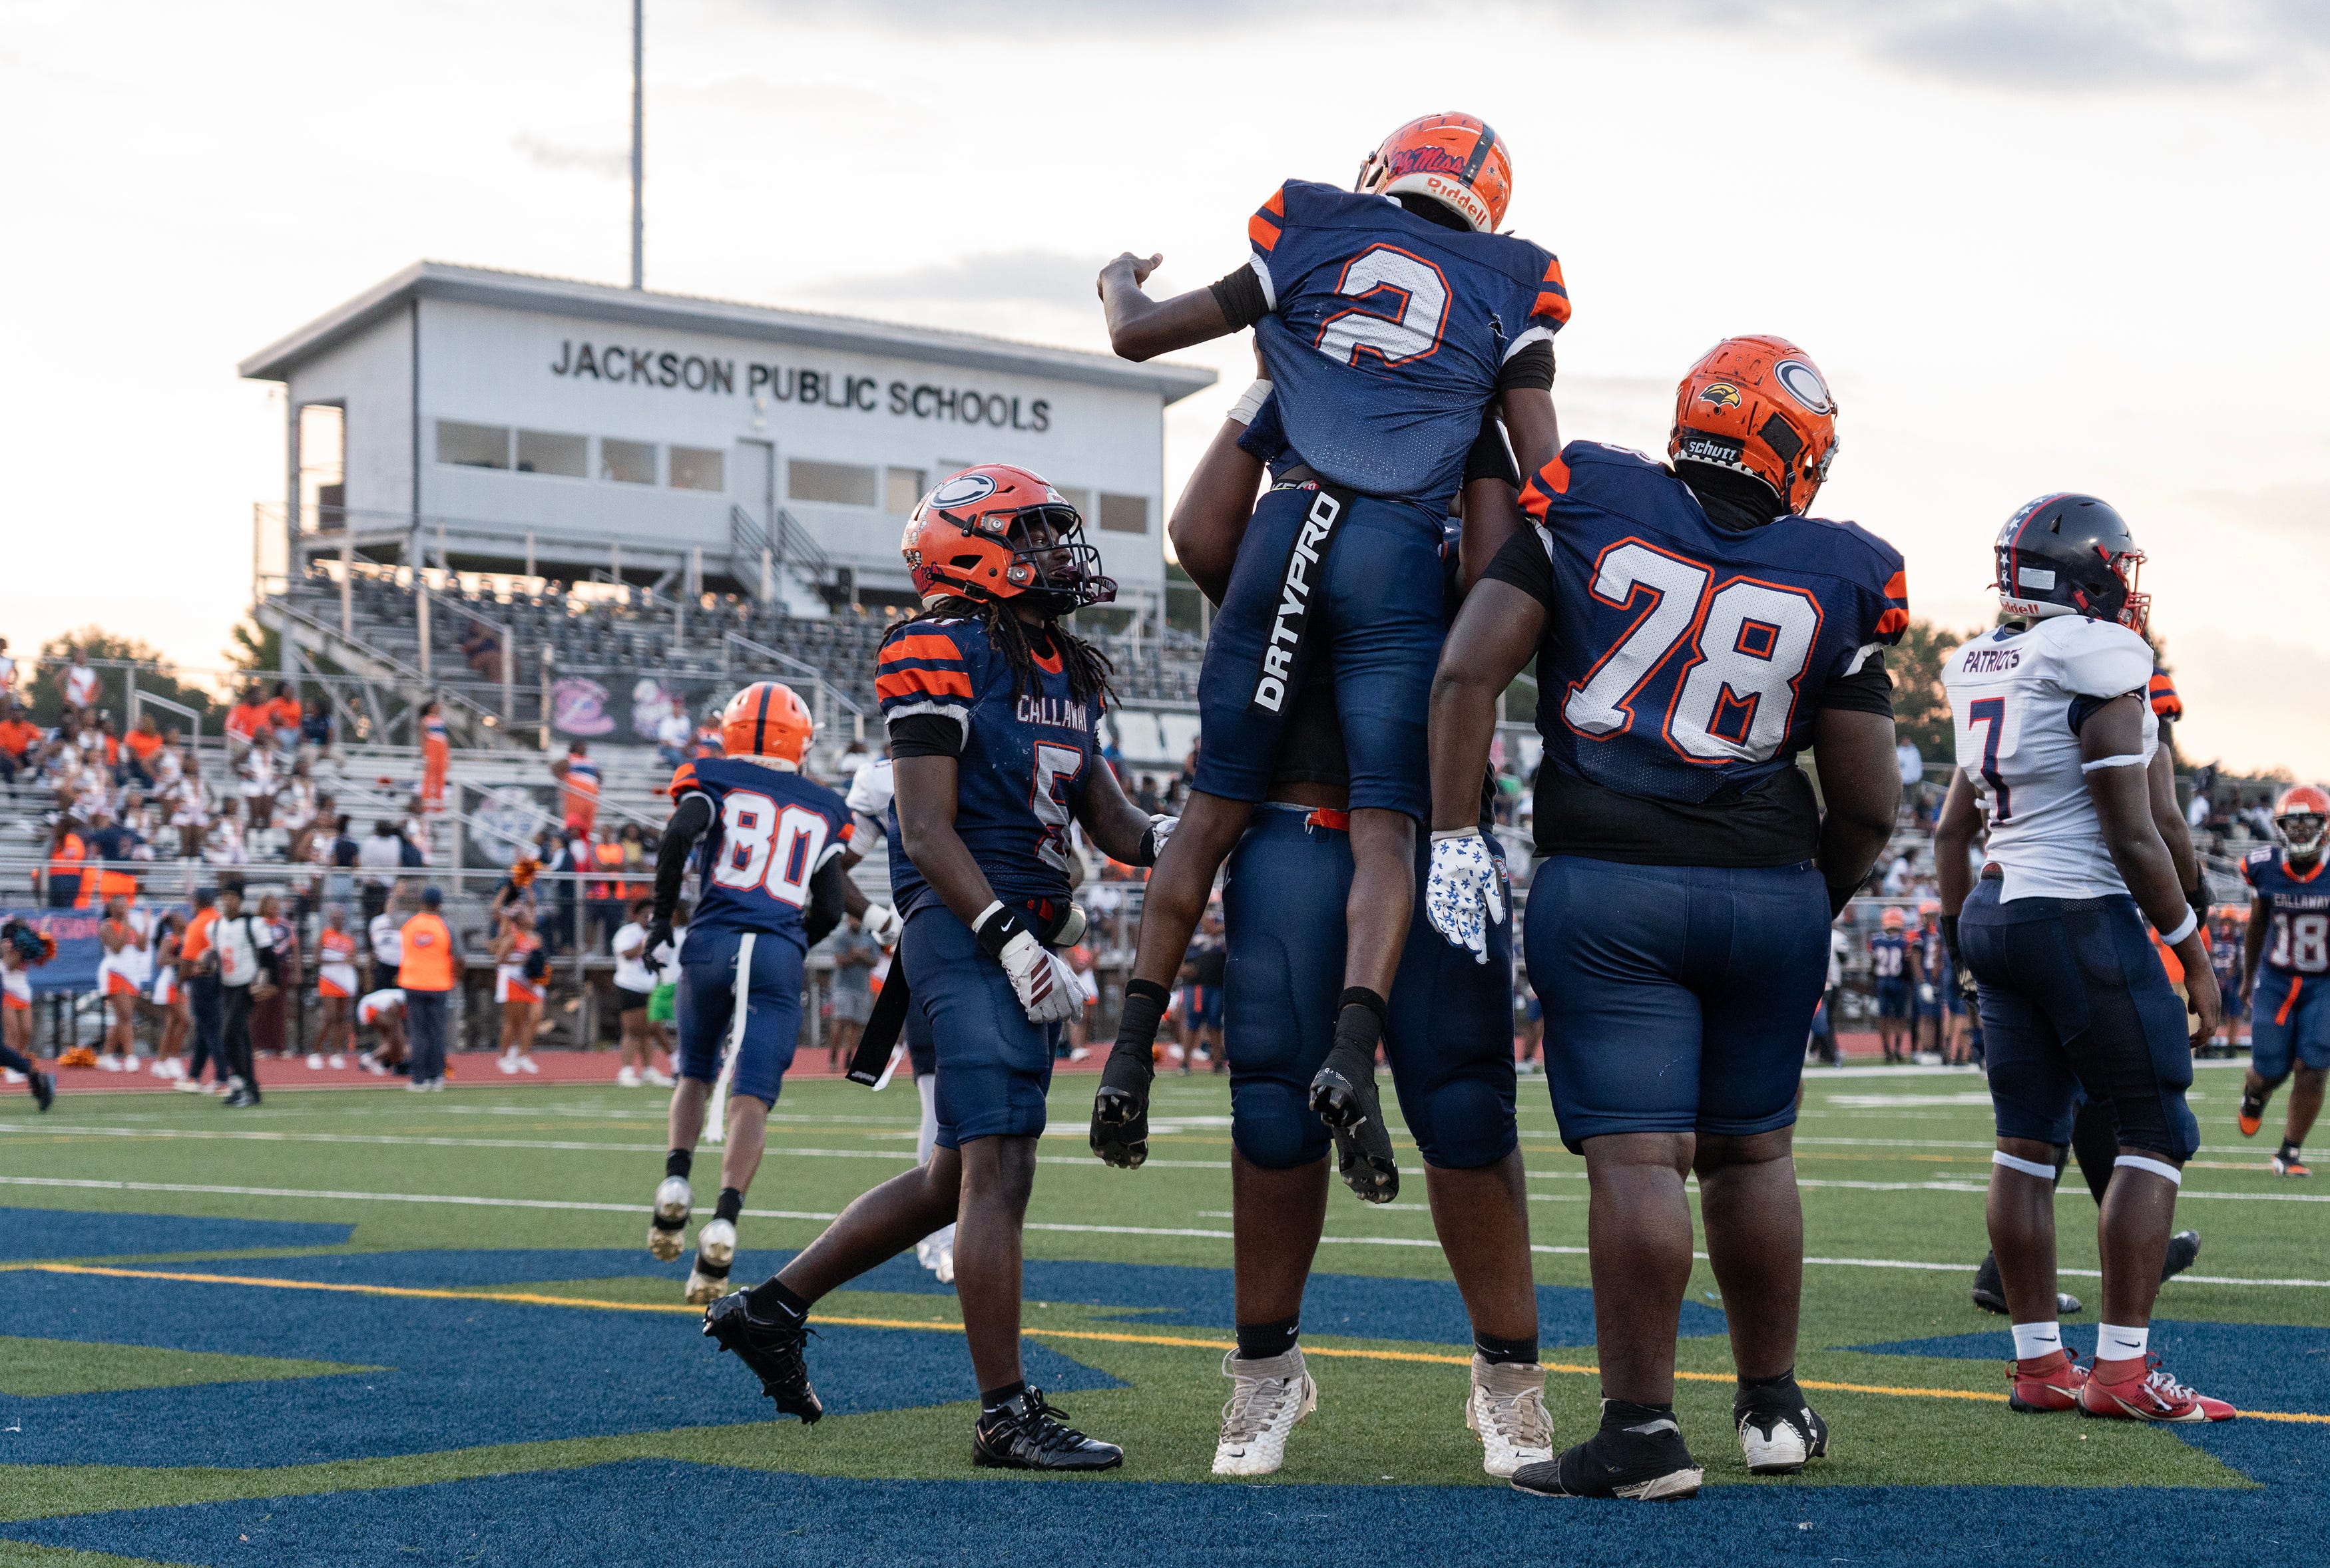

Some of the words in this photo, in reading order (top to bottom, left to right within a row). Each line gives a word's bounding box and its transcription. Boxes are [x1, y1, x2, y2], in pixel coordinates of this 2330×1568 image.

[1411, 146, 1465, 176] Miss
[1427, 177, 1488, 226] Riddell
[1314, 242, 1453, 368] 2
[552, 339, 733, 395] JACKSON
[748, 363, 877, 411] PUBLIC
[889, 380, 1050, 433] SCHOOLS
[1689, 440, 1738, 461] schutt
[1254, 491, 1341, 712] DRTYPRO
[1561, 536, 1824, 764] 78
[1963, 648, 2023, 673] PATRIOTS
[1016, 694, 1088, 733] CALLAWAY
[1029, 740, 1083, 874] 5
[1969, 696, 2012, 827] 7
[712, 788, 829, 910] 80
[2270, 912, 2329, 972] 18
